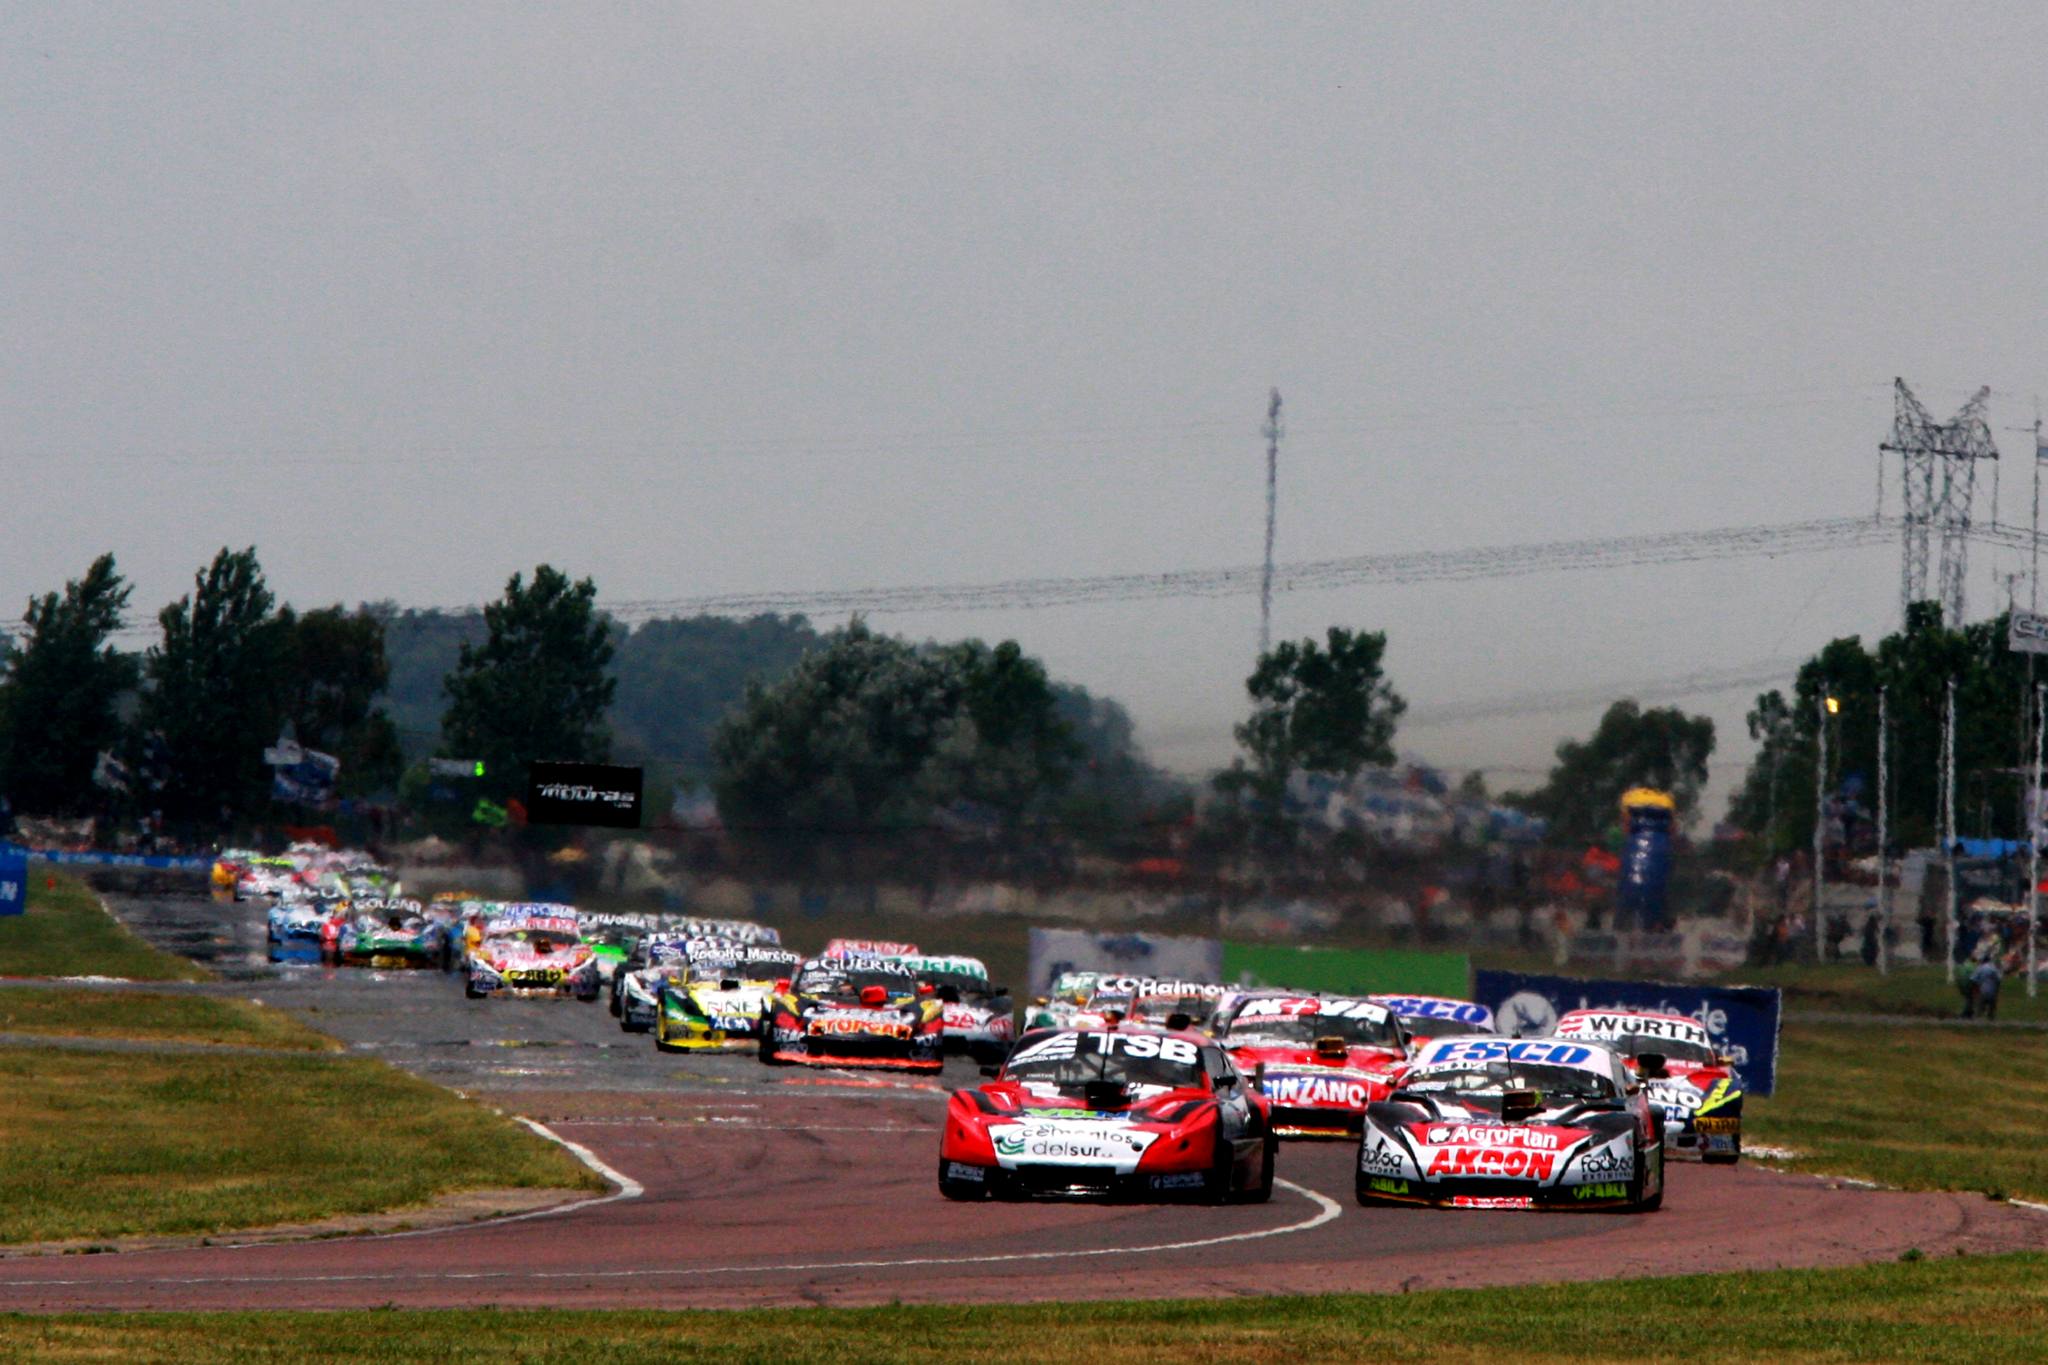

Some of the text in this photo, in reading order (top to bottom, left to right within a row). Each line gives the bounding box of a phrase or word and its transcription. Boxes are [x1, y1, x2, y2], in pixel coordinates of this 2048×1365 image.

[820, 957, 910, 977] GUERRA
[1590, 1016, 1705, 1043] WÜRTH
[1087, 1032, 1198, 1066] TSB
[1429, 1042, 1592, 1065] ESCO
[1426, 1149, 1555, 1182] AKRON
